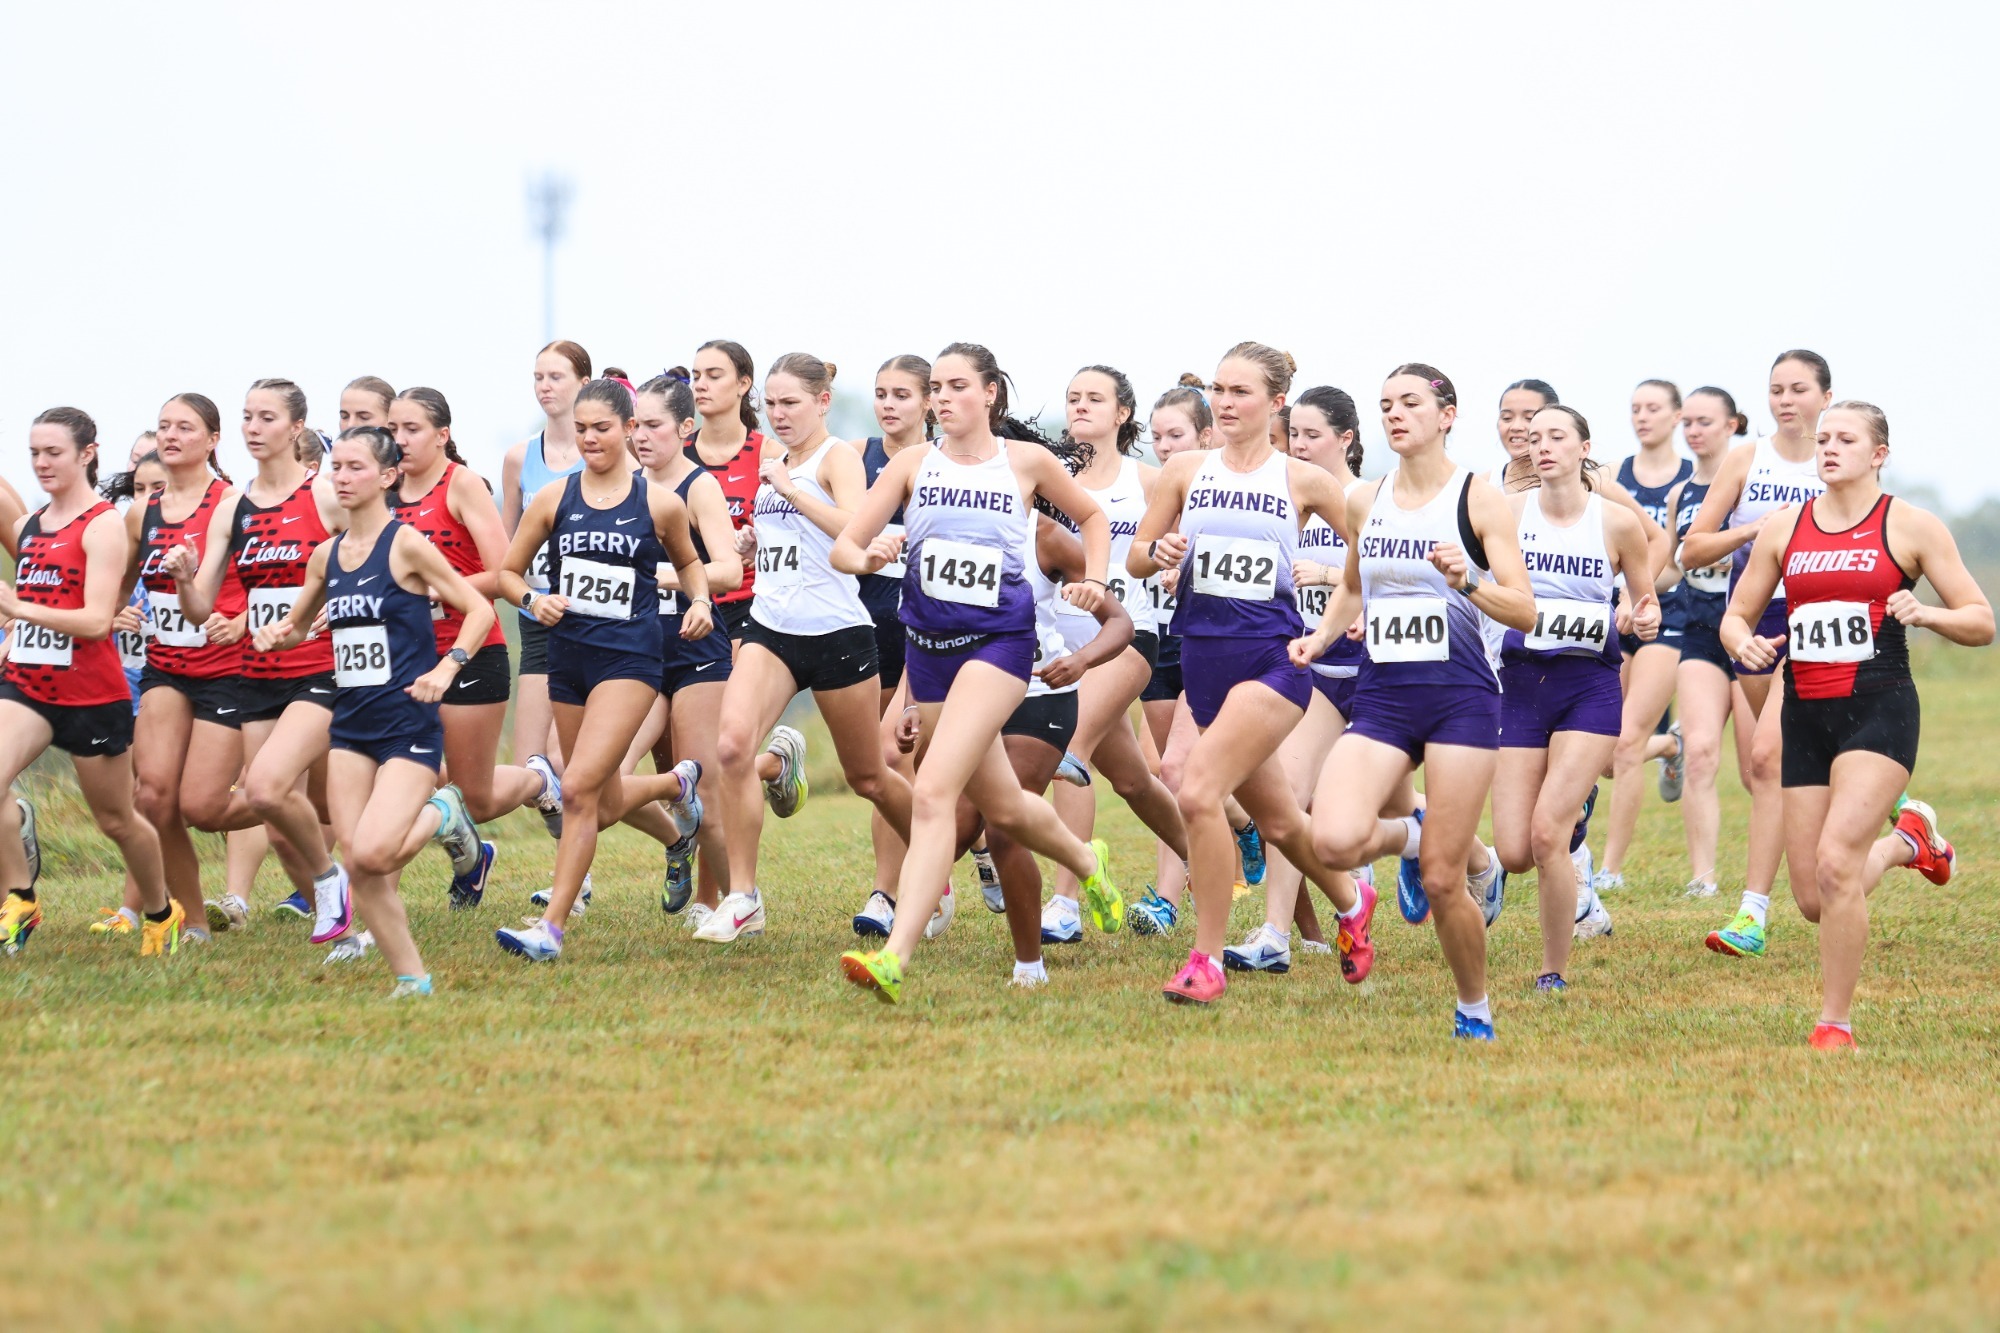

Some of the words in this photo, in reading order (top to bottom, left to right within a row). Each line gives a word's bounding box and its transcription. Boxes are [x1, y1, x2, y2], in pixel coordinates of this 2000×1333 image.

[918, 485, 1013, 514] SEWANEE
[1188, 488, 1288, 520] SEWANEE
[1748, 482, 1826, 502] SEWAN
[237, 536, 302, 566] Lions
[558, 531, 641, 558] BERRY
[757, 545, 799, 573] 1374
[1361, 536, 1440, 560] SEWAN
[16, 557, 64, 586] Lions
[529, 552, 549, 576] 12
[924, 554, 997, 591] 1434
[1197, 551, 1274, 586] 1432
[1521, 549, 1603, 578] EWANEE
[1786, 549, 1879, 577] RHODES
[563, 572, 630, 605] 1254
[1149, 584, 1177, 610] 12
[1297, 587, 1333, 616] 143
[251, 603, 291, 628] 126
[327, 594, 384, 622] ERRY
[17, 622, 70, 650] 1269
[1370, 615, 1444, 646] 1440
[1534, 611, 1605, 644] 1444
[1793, 615, 1868, 650] 1418
[120, 632, 154, 656] 12
[335, 642, 386, 671] 1258
